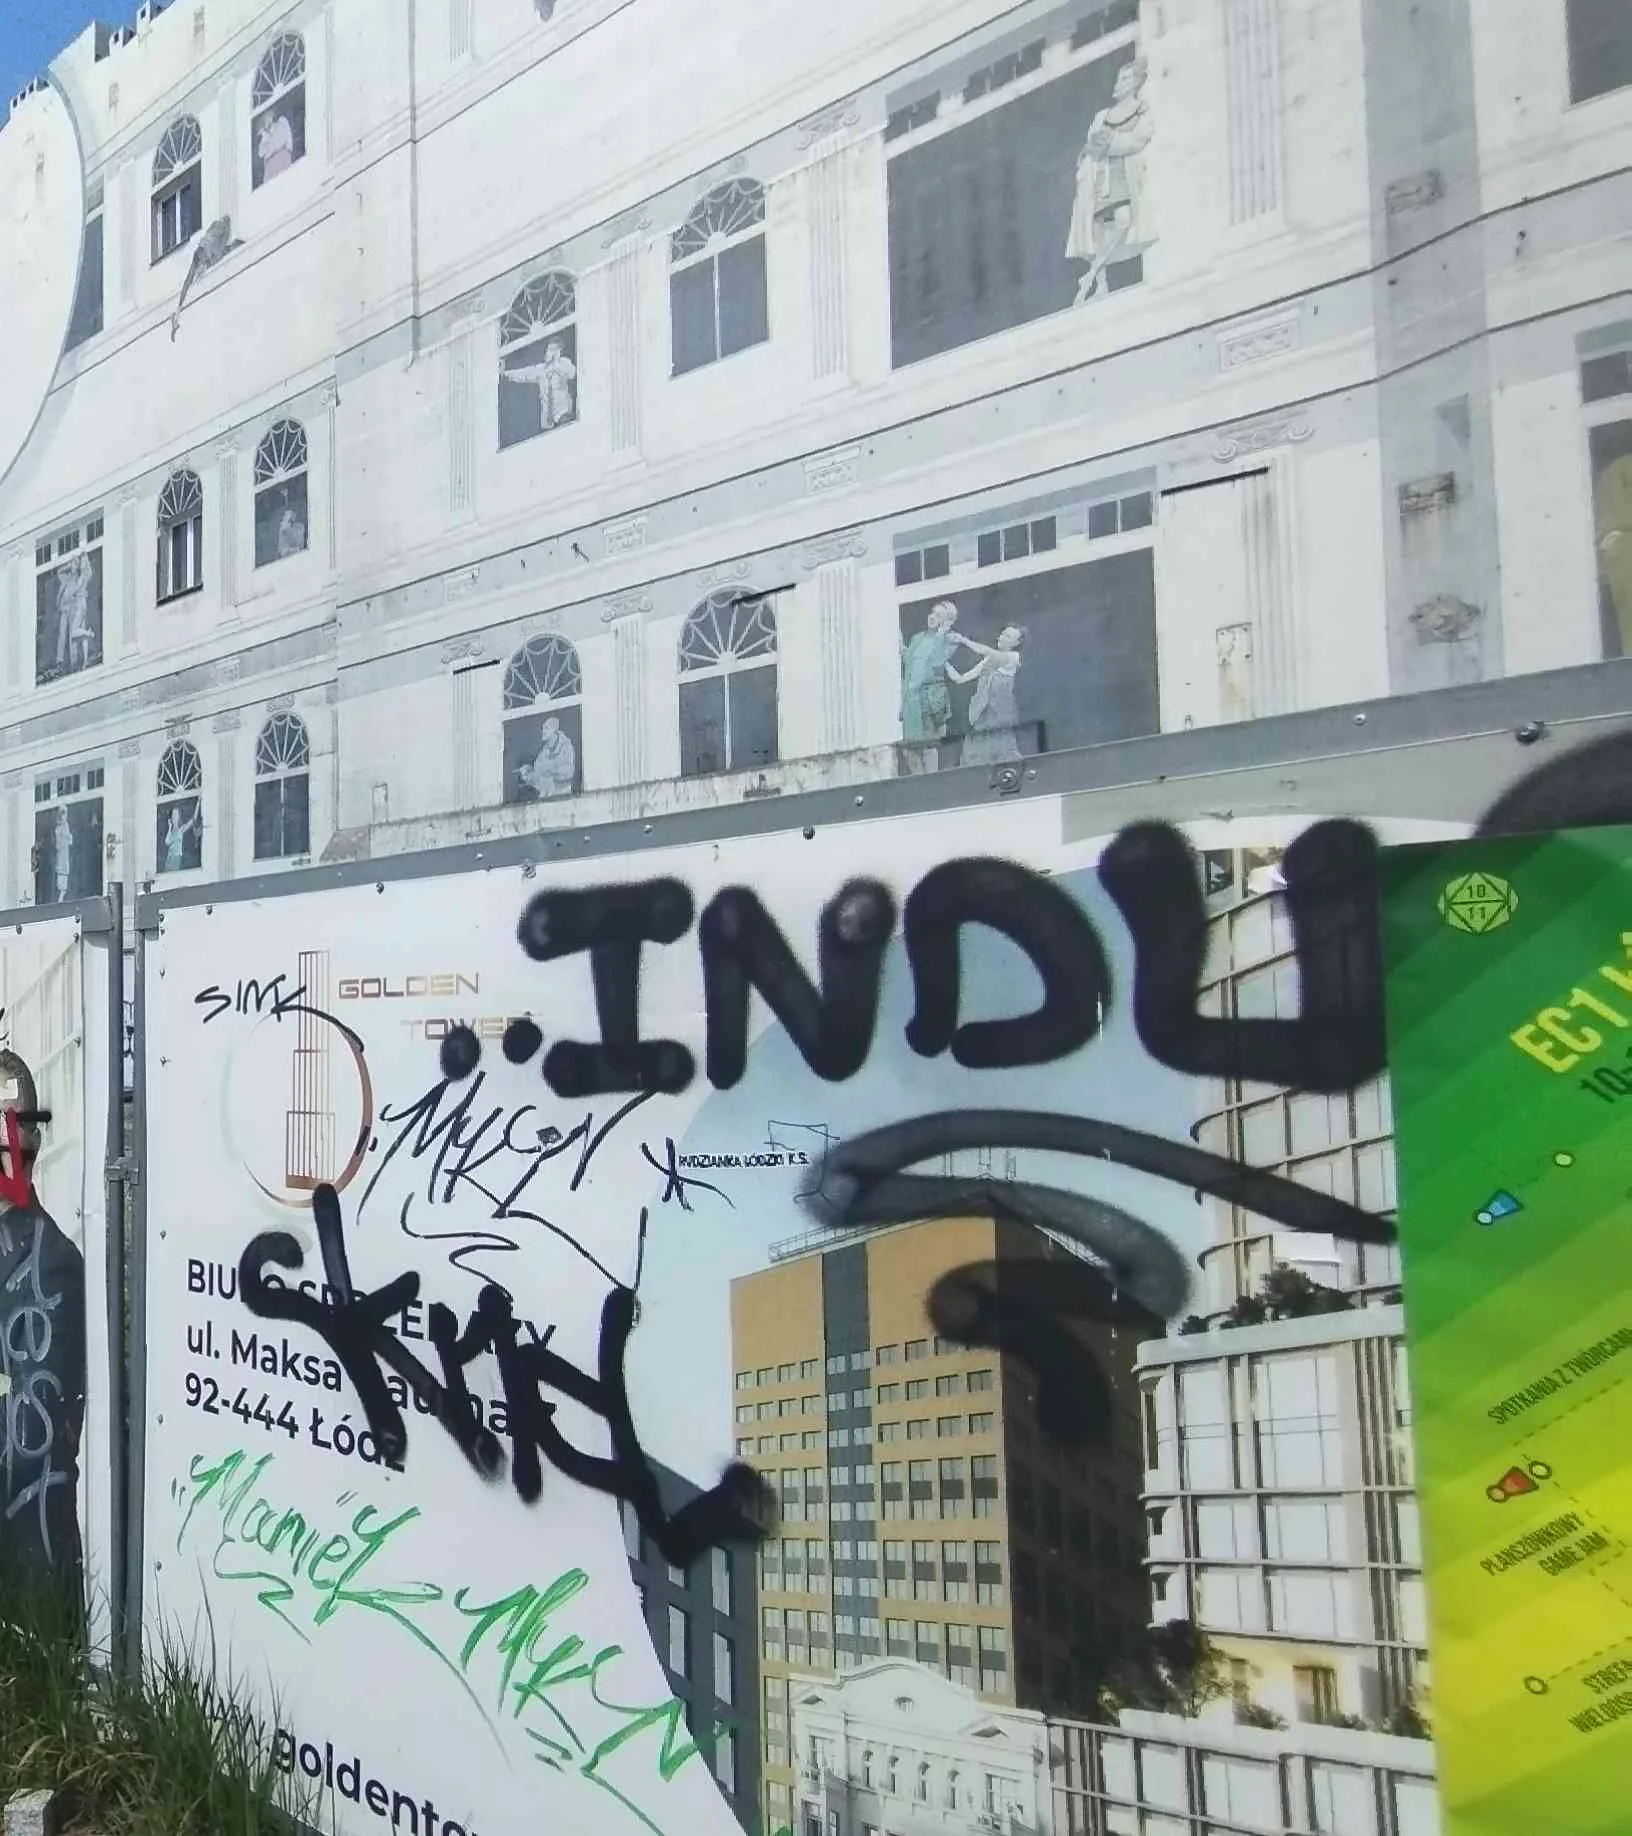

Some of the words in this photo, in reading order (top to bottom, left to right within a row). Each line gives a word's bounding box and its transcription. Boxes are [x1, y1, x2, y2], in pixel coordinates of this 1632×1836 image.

[1467, 885, 1486, 898] 10
[1467, 906, 1486, 921] 11
[338, 973, 480, 999] GOLDEN
[1510, 983, 1630, 1073] EC1
[187, 1320, 221, 1359] ul.
[231, 1329, 343, 1393] Maksa
[184, 1372, 300, 1439] 92-444
[309, 1406, 406, 1474] Łód
